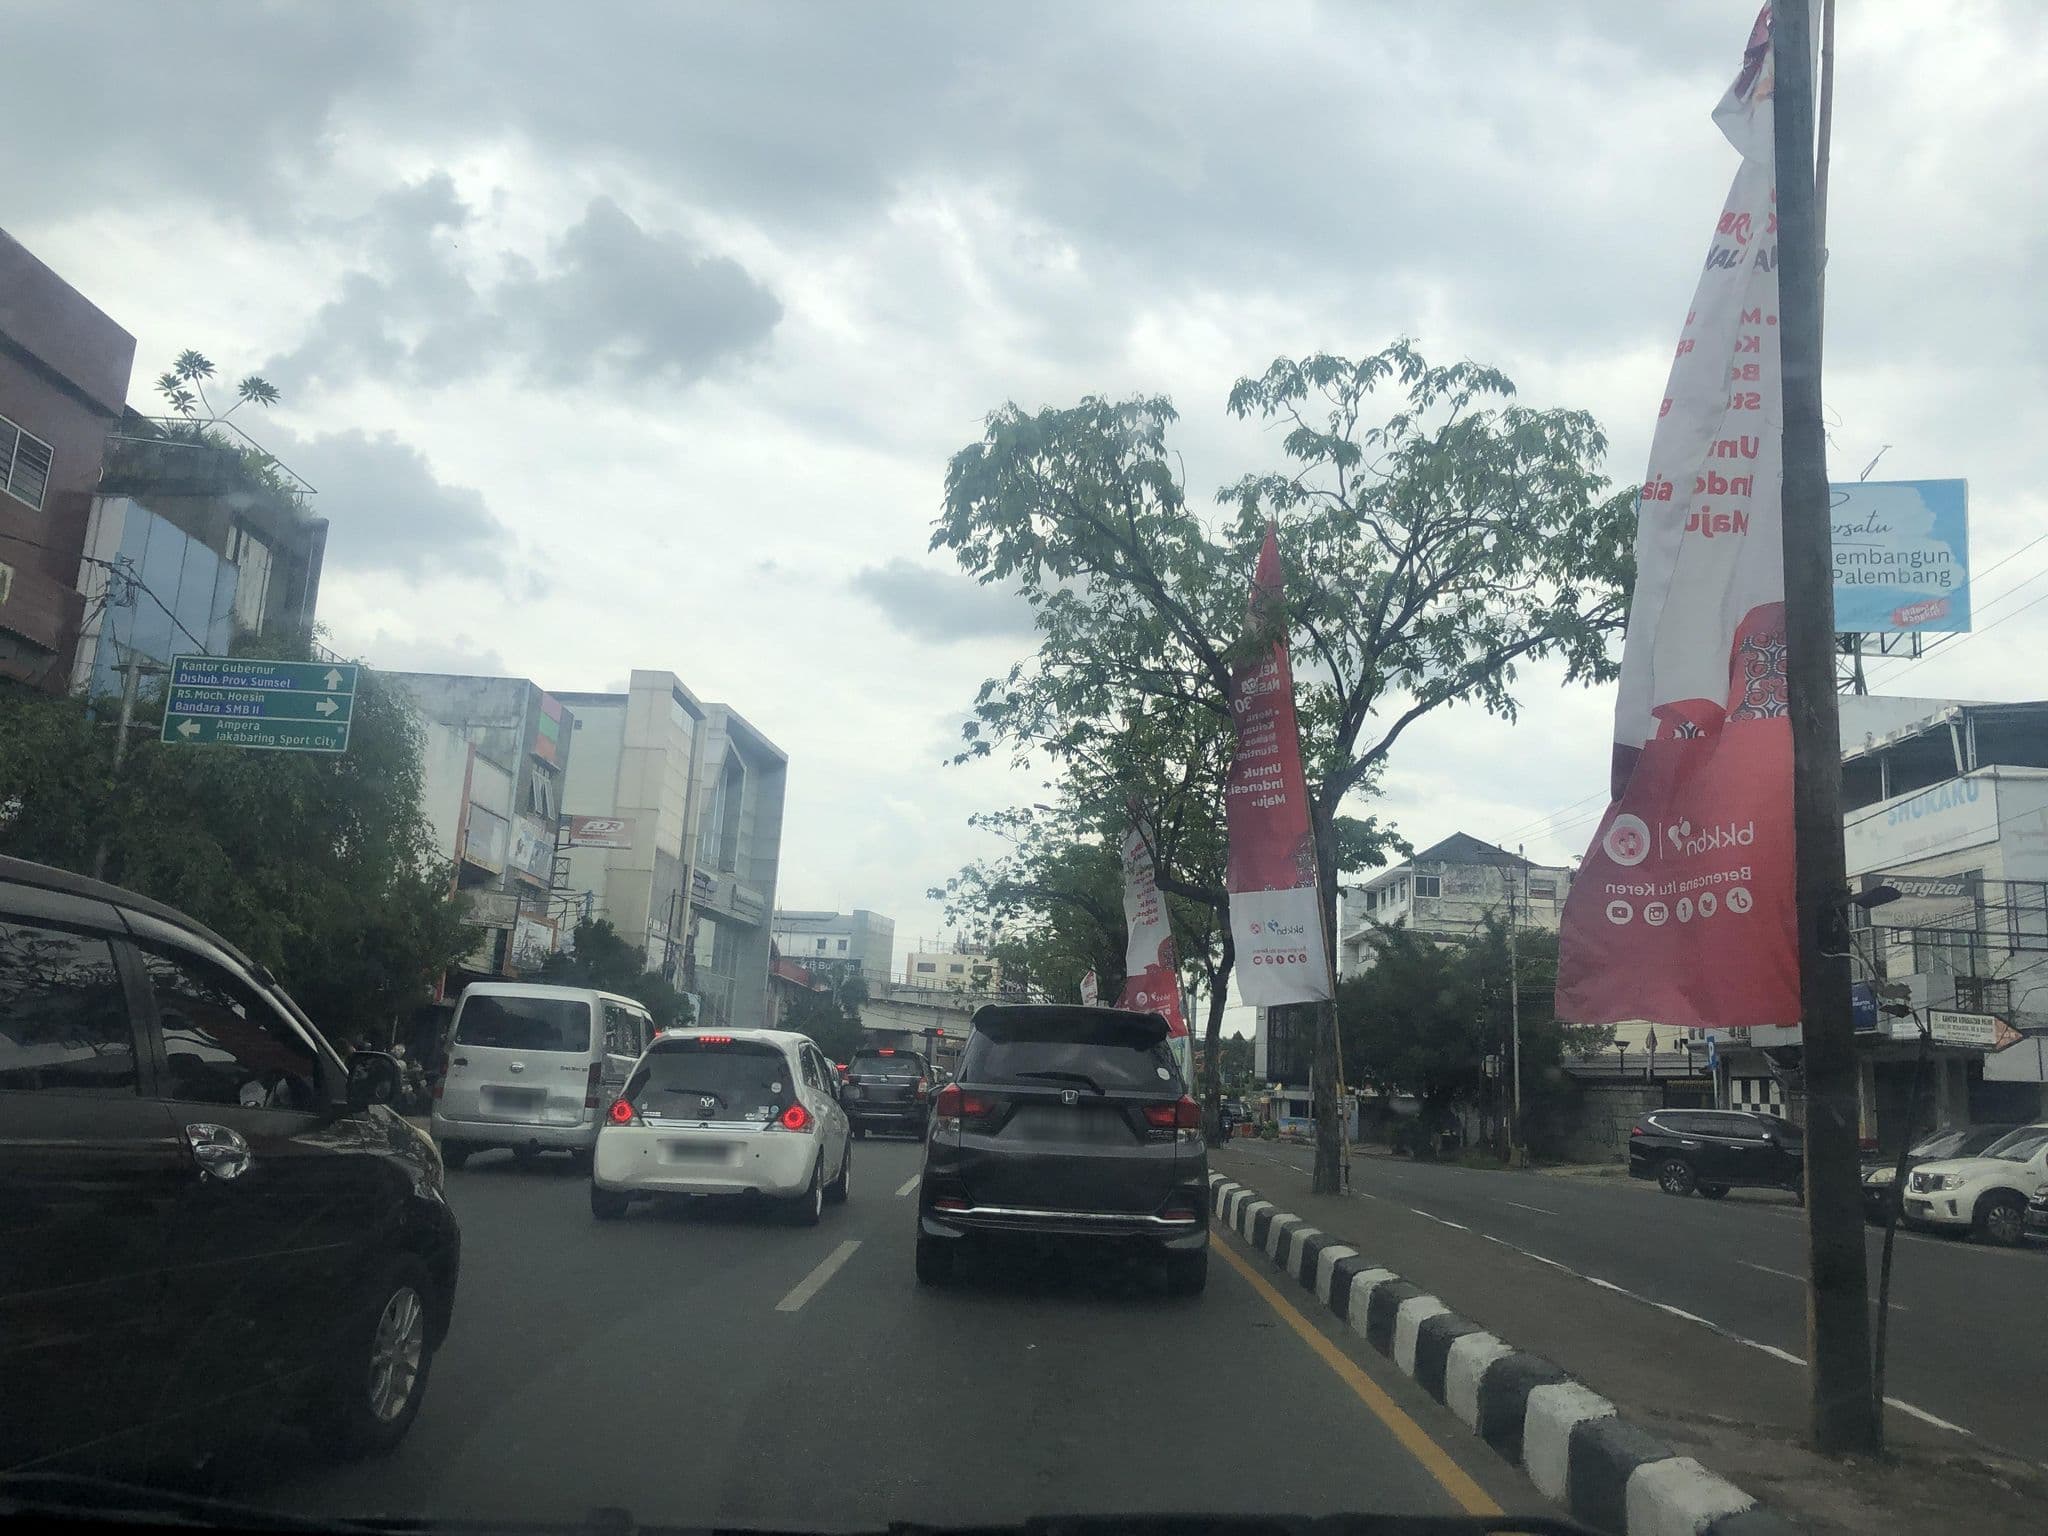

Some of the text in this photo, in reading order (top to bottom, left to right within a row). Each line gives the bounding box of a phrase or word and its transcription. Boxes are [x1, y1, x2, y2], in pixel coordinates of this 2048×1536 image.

[1830, 510, 1893, 536] ersatu
[1836, 549, 1950, 568] embangun
[1832, 568, 1952, 588] Palembang
[182, 661, 276, 675] Kantor Gubernur
[179, 673, 291, 689] Dishub. Prov. Sumsel
[228, 692, 265, 703] Hoesin
[175, 702, 220, 713] Bandara
[225, 704, 249, 714] SMB
[216, 720, 260, 732] Ampera
[280, 735, 309, 747] Sport
[315, 736, 337, 747] City
[1880, 877, 1966, 897] Energizer
